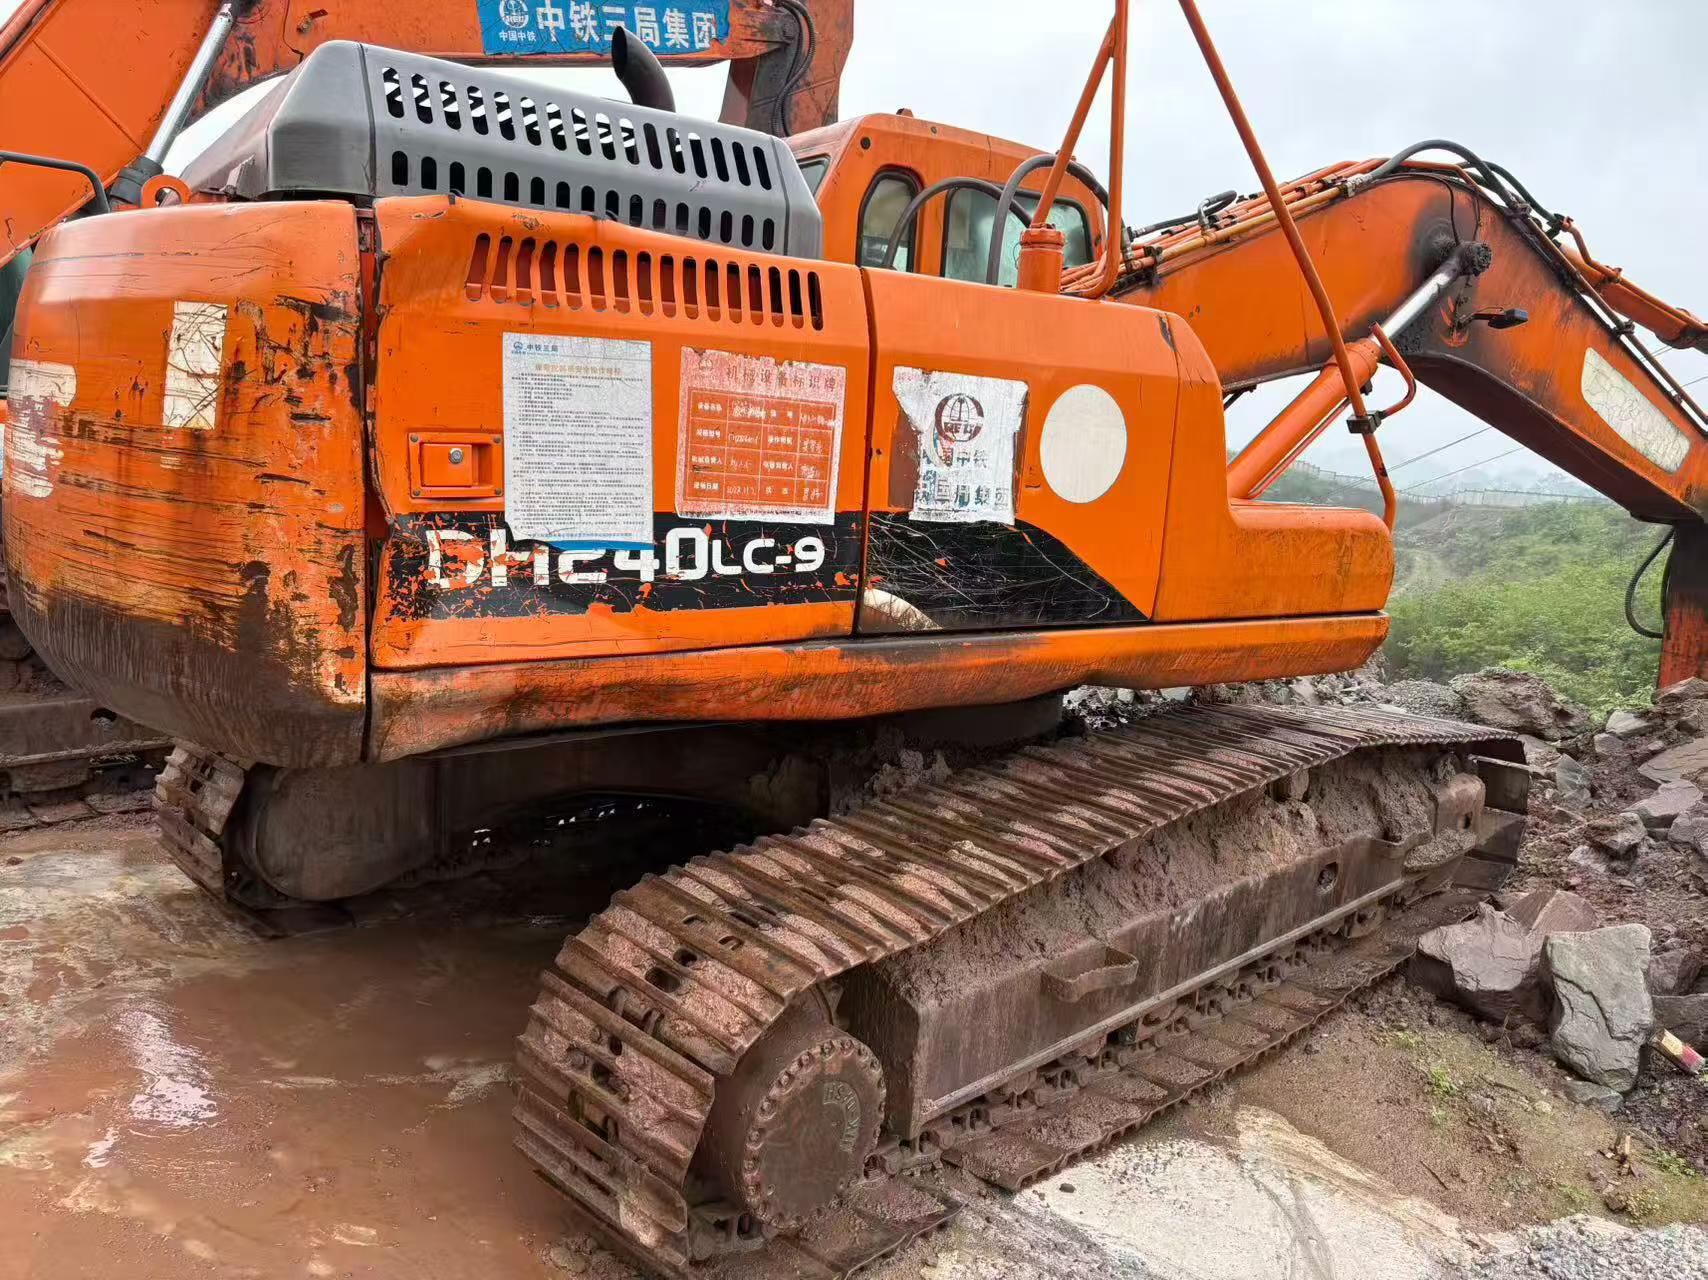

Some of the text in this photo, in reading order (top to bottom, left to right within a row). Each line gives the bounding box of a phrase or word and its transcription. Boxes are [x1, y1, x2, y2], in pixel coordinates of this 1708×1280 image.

[498, 30, 537, 42] 中国中铁
[536, 0, 717, 48] 中铁三局集团
